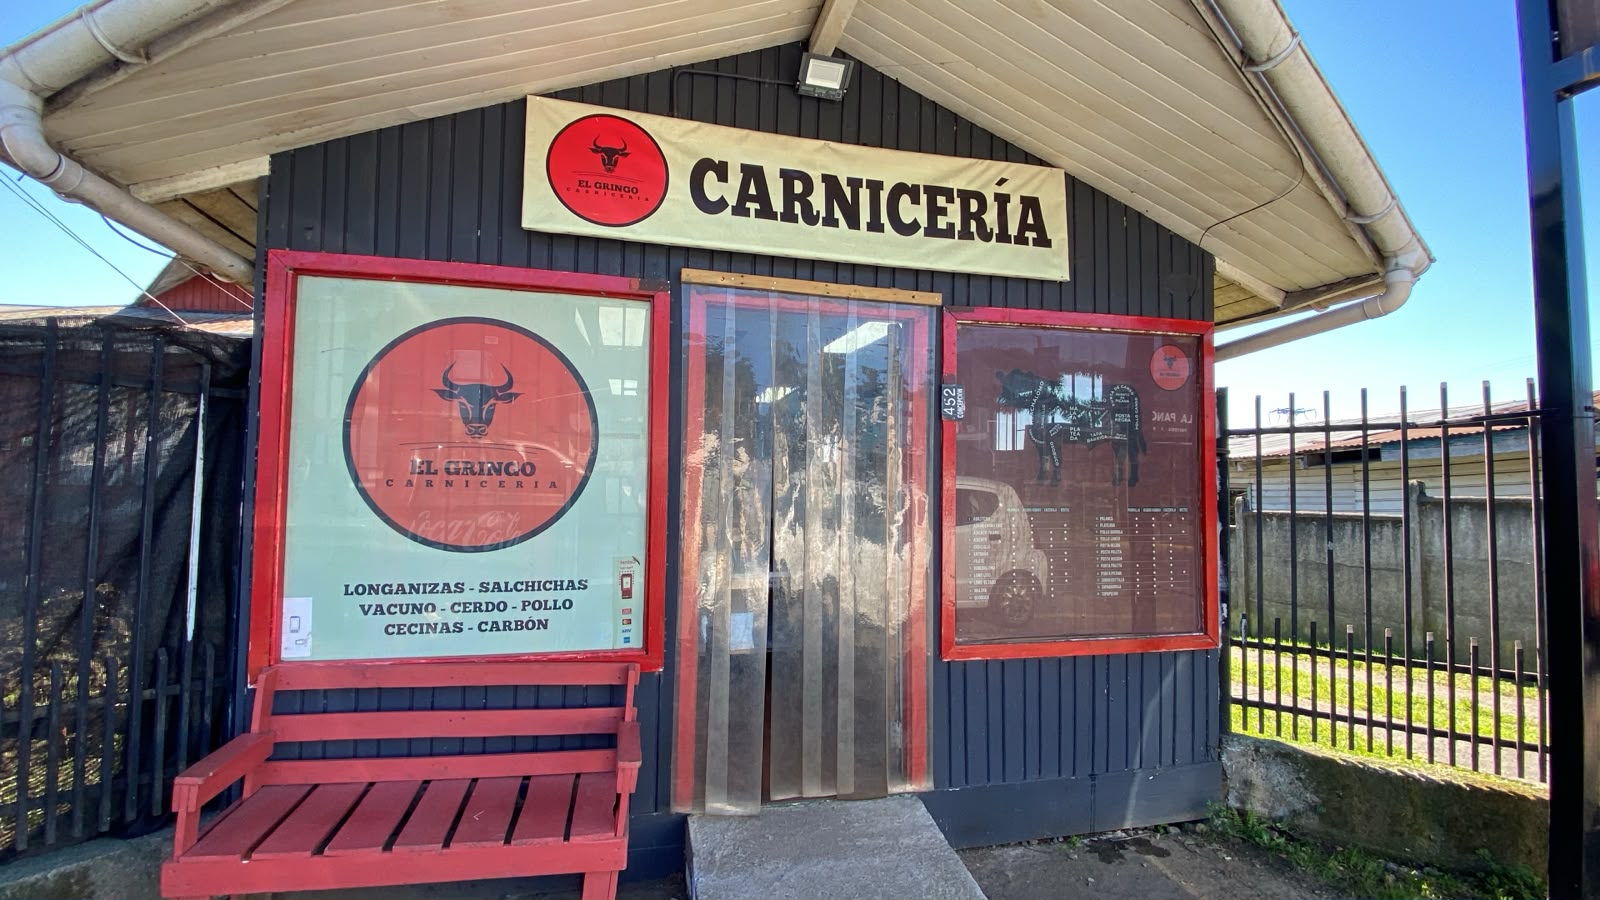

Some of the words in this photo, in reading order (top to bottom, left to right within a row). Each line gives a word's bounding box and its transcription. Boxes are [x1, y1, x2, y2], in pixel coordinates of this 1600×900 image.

[566, 187, 649, 202] CARNICERIA
[577, 179, 592, 189] EL
[593, 181, 639, 195] GRINGO
[689, 156, 1052, 249] CARNICERÍA
[943, 387, 956, 416] 452
[409, 459, 438, 476] EL
[444, 460, 537, 477] GRINGO
[385, 478, 558, 489] CARNICERIA
[343, 582, 465, 596] LONGANIZAS
[478, 579, 589, 594] SALCHICHAS
[358, 602, 437, 616] VACUNO
[450, 600, 508, 614] CERDO
[521, 598, 574, 612] POLLO
[383, 621, 464, 636] CECINAS
[477, 616, 550, 633] CARBÓN
